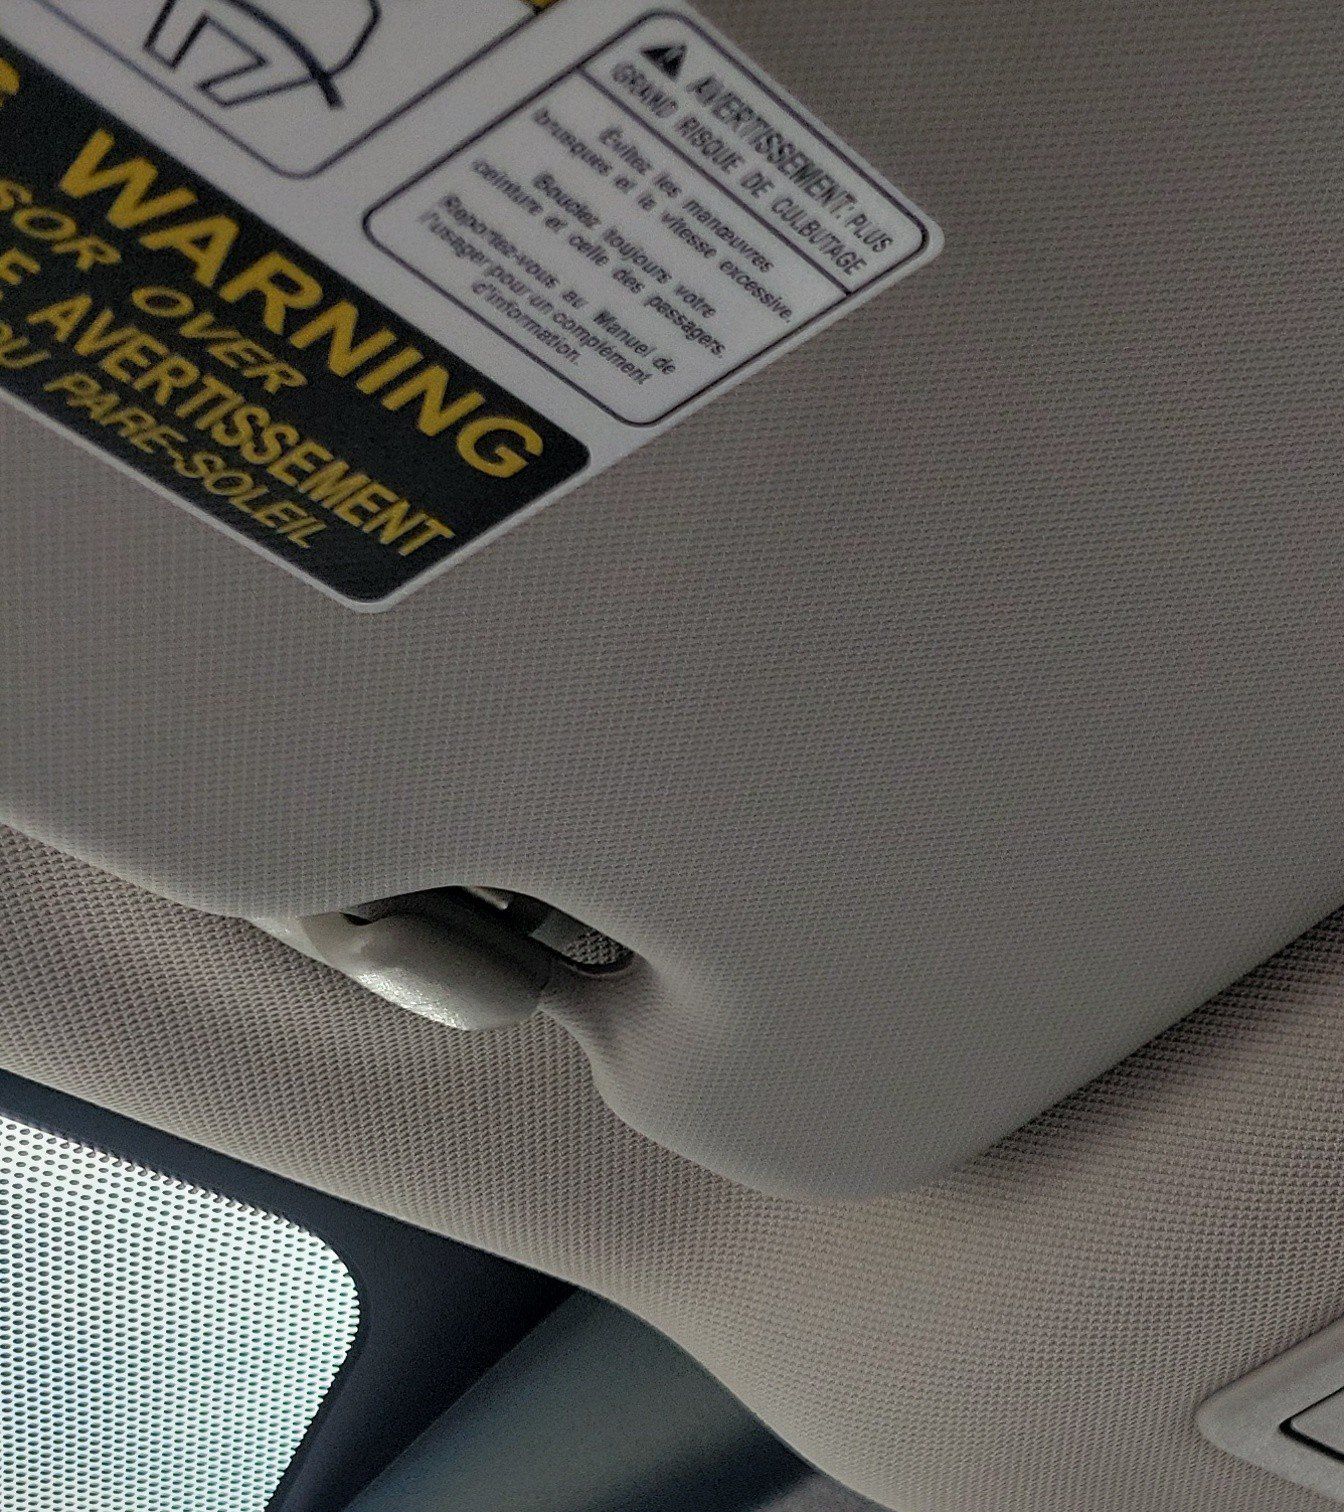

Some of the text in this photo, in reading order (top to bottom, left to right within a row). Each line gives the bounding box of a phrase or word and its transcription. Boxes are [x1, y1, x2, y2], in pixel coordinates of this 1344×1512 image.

[531, 108, 793, 324] brusques et la vitesse excessive.
[531, 171, 718, 319] Bouclez toujours votre
[611, 61, 867, 275] GRAND RISQUE DE CULBUTAGE
[654, 171, 683, 198] les
[847, 213, 893, 253] PLUS
[59, 126, 544, 479] WARNING
[469, 158, 726, 358] ceinture et celle des passagers.
[484, 263, 534, 299] pour
[527, 293, 555, 317] un
[552, 310, 655, 387] complément
[562, 287, 588, 310] au
[592, 309, 657, 358] Manuel
[652, 352, 678, 375] de
[131, 285, 308, 395] OVER
[26, 294, 456, 557] AVERTISSEMENT
[43, 372, 328, 549] PARE-SOLEIL
